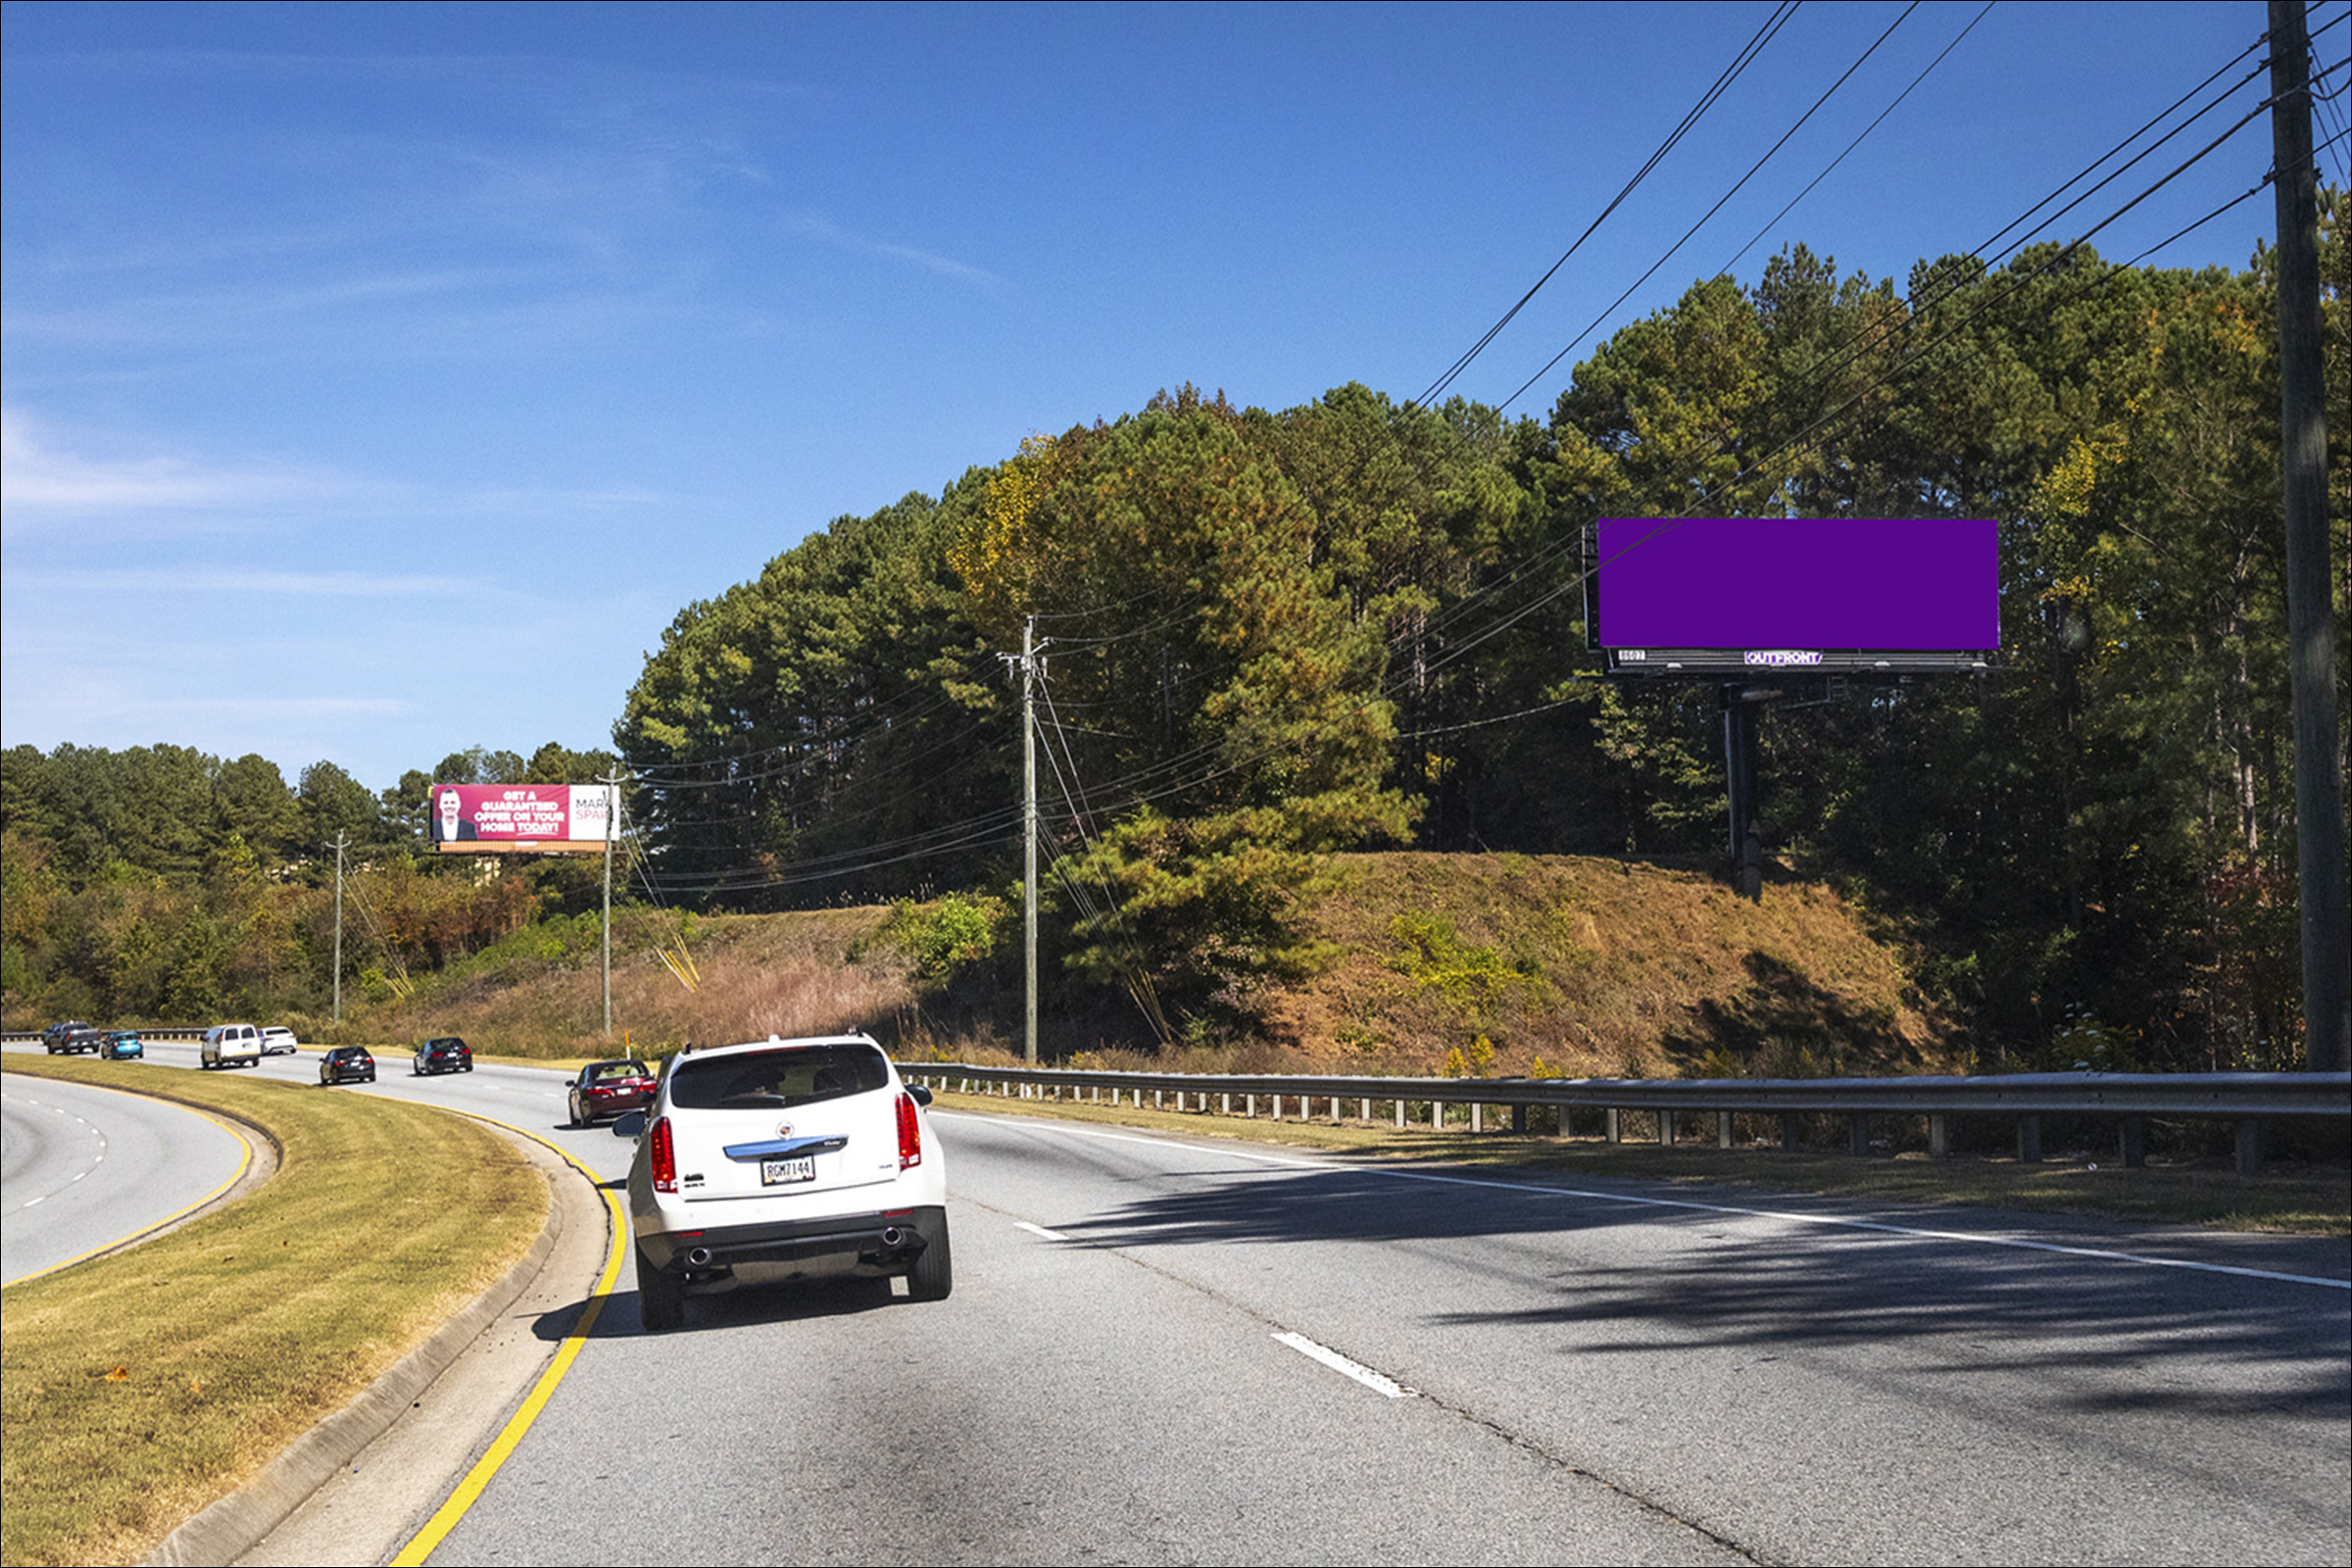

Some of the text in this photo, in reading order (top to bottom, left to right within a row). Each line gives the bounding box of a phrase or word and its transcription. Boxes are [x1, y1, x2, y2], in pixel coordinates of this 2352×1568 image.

[1746, 651, 1820, 663] OUTFRONT
[503, 791, 536, 801] GET A
[481, 802, 559, 811] GUARANTEED
[474, 811, 564, 822] OFFER ON YOUR
[480, 822, 559, 832] HOME TODAY!
[766, 1161, 810, 1177] RGM7144
